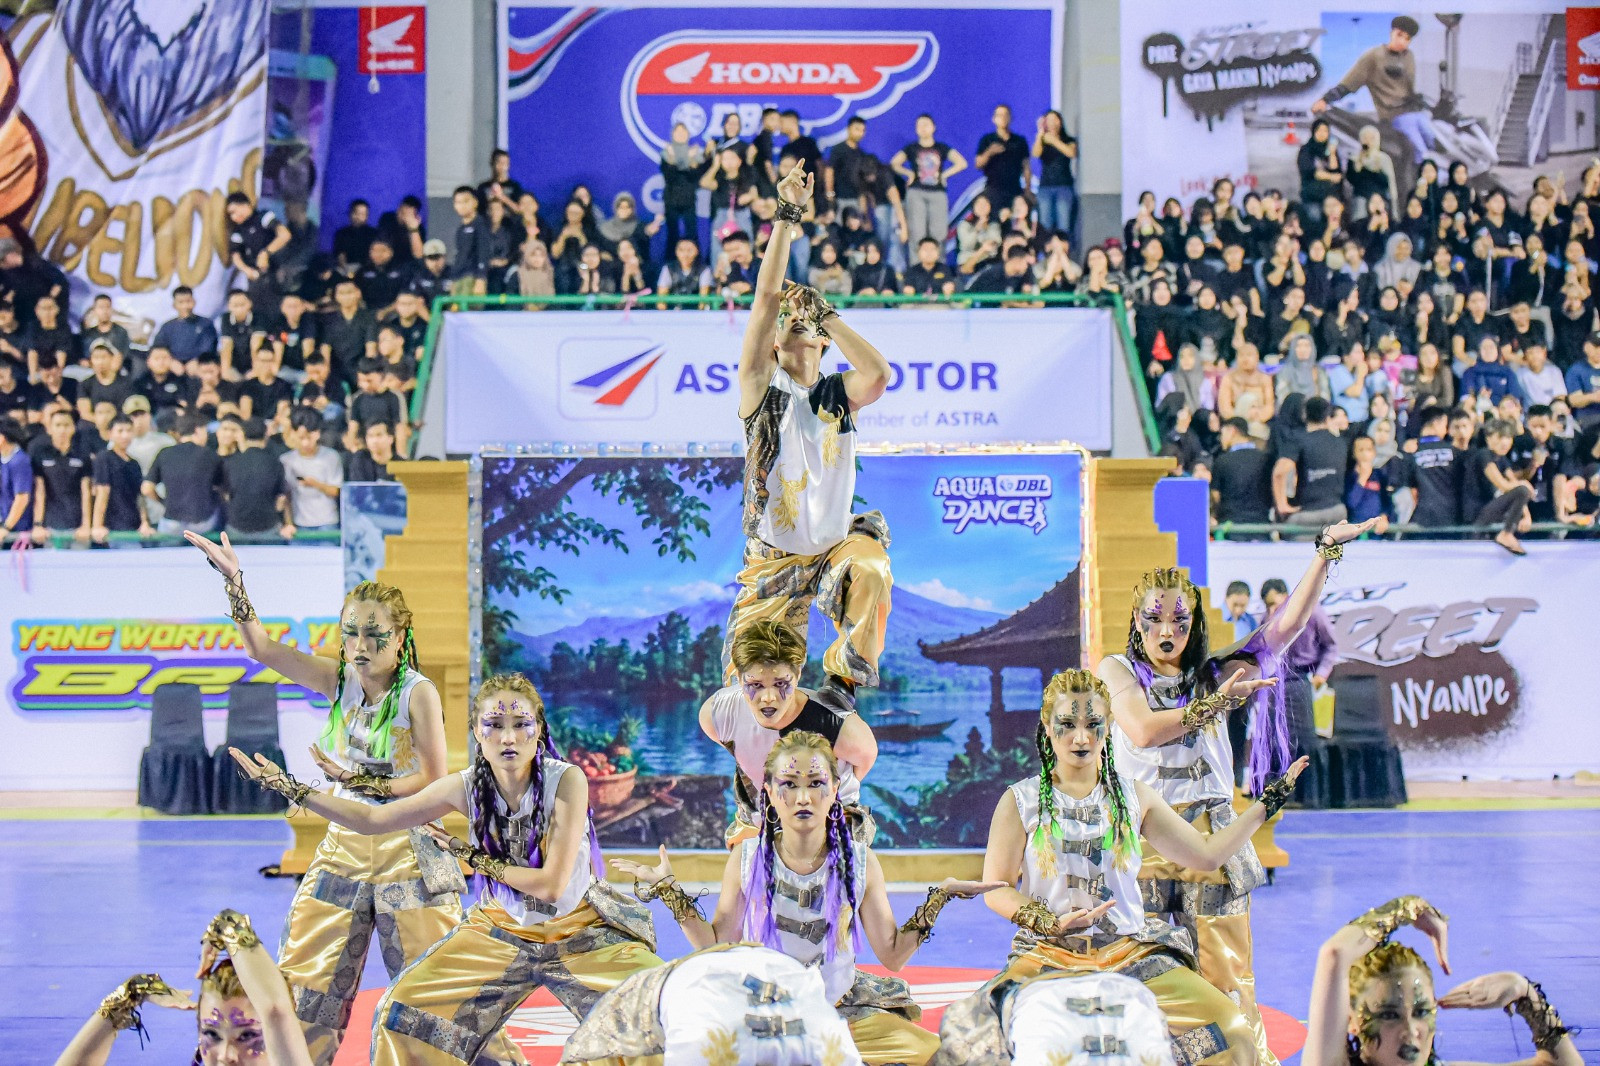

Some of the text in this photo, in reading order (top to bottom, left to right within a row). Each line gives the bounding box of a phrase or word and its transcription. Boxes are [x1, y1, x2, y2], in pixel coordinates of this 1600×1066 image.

[709, 62, 861, 84] HONDA
[702, 103, 779, 138] DB
[935, 411, 999, 427] ASTRA
[933, 477, 1049, 499] AQUA DBL
[942, 498, 1036, 534] DANCE
[18, 624, 115, 651] YANG
[1329, 597, 1540, 668] REET
